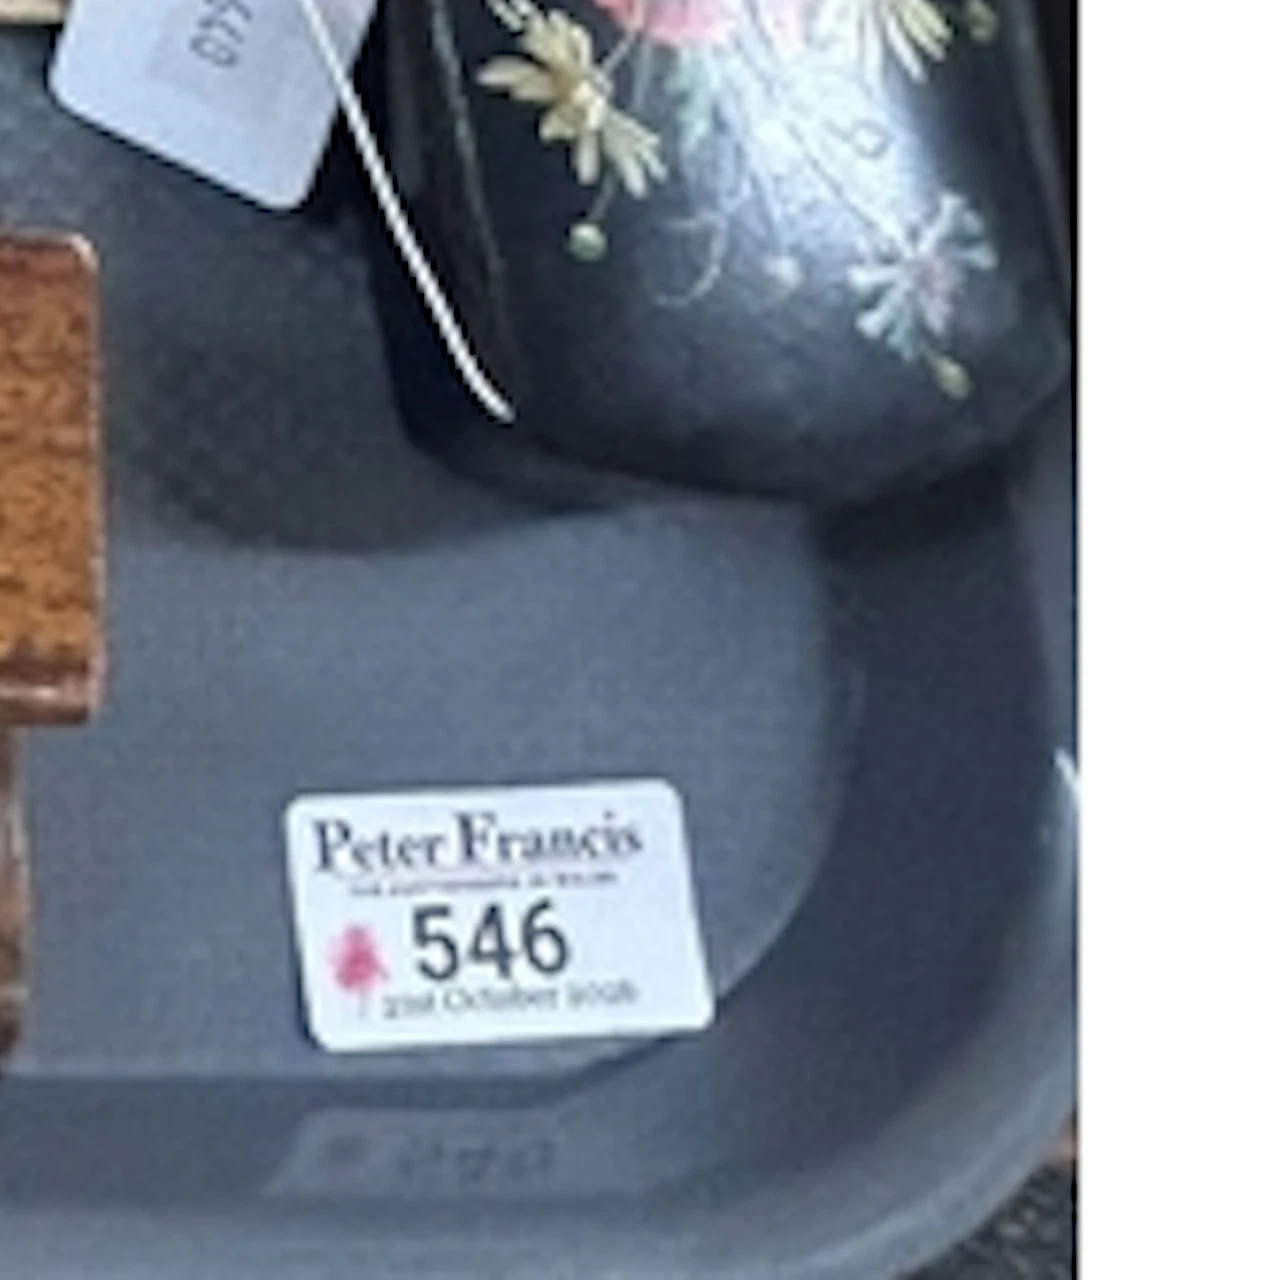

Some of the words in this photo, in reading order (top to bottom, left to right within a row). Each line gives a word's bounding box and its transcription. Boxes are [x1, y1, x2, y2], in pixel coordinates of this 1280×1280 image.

[312, 815, 448, 874] Peter
[453, 809, 643, 865] Francis
[411, 896, 572, 982] 546
[441, 982, 559, 1014] October
